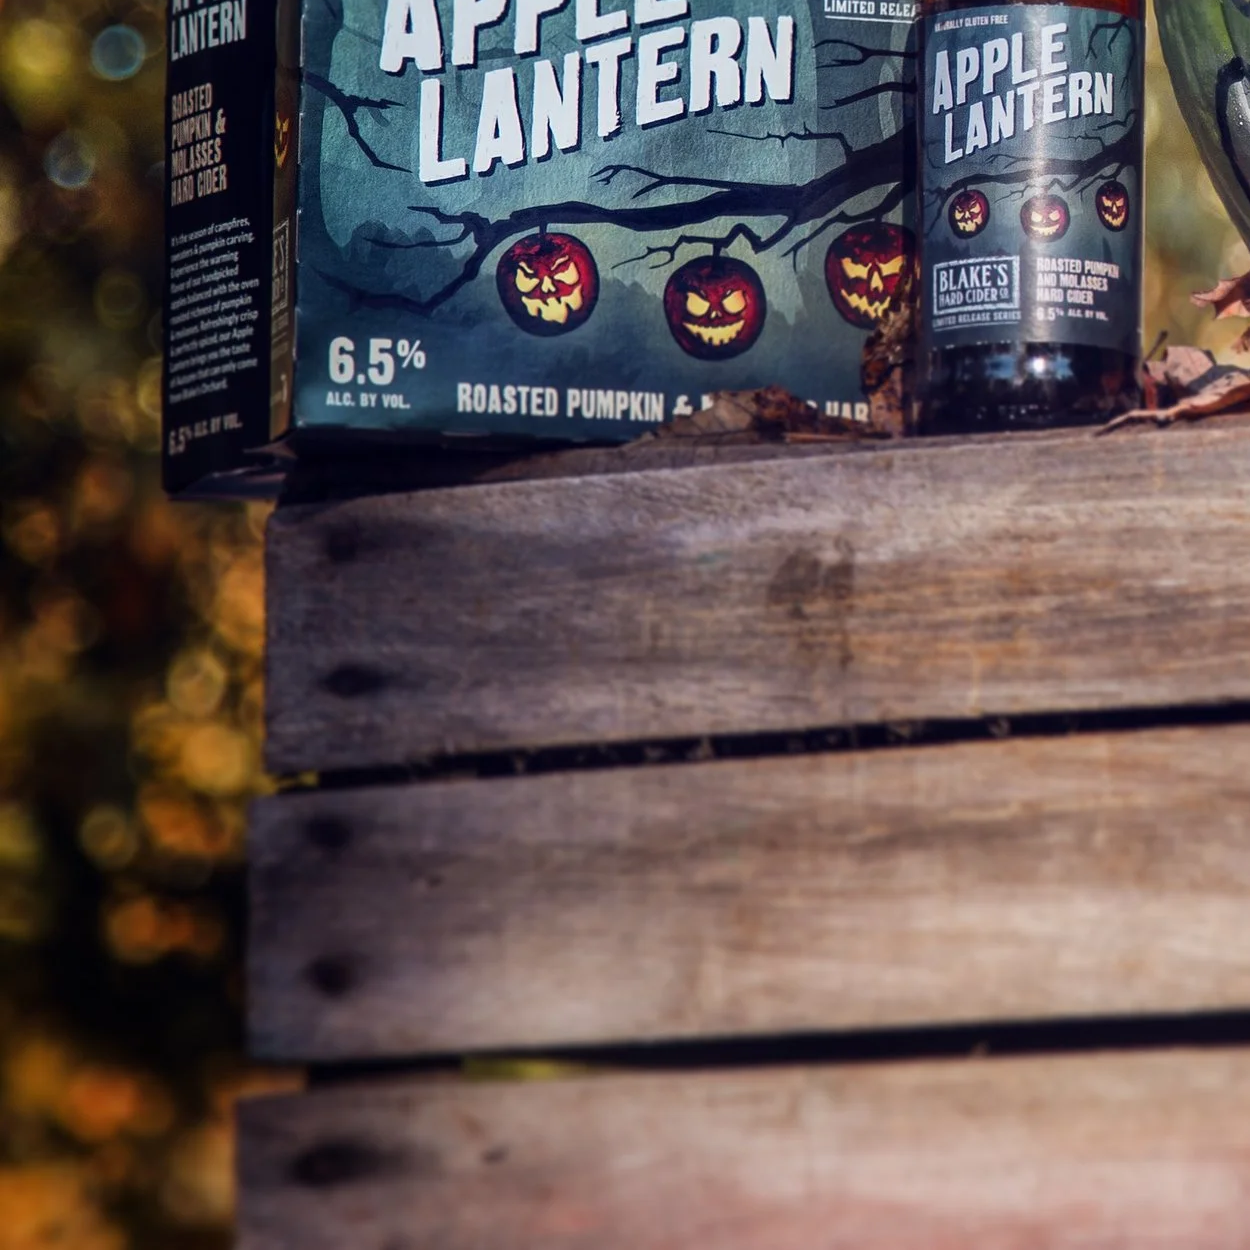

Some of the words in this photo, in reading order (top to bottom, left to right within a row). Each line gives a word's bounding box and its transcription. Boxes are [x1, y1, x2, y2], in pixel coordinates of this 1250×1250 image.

[965, 16, 989, 27] GLUTEN
[990, 14, 1008, 25] FREE
[933, 23, 1068, 114] APPLE
[172, 82, 212, 122] ROASTED
[419, 16, 795, 184] LANTERN
[945, 71, 1113, 164] LANTERN
[172, 111, 211, 150] PUMPKIN
[215, 107, 226, 135] &
[172, 137, 222, 180] MOLASSES
[171, 175, 194, 207] HARD
[197, 163, 227, 198] CIDER
[940, 263, 1009, 292] BLAKE'S
[1036, 257, 1082, 273] ROASTED
[1084, 260, 1119, 278] PUMPKIN
[228, 280, 240, 292] the
[241, 278, 259, 290] oven
[1037, 273, 1057, 287] AND
[1060, 274, 1108, 292] MOLASSES
[221, 293, 252, 312] pumpkin
[939, 291, 963, 307] HARD
[965, 288, 998, 304] CIDER
[1036, 287, 1064, 302] HARD
[1066, 289, 1094, 305] CIDER
[240, 309, 258, 322] crisp
[958, 312, 991, 323] RELEASE
[993, 311, 1021, 321] SERIES
[231, 325, 254, 340] Apple
[329, 336, 426, 385] 6.5%
[326, 391, 355, 407] ALC.
[360, 393, 377, 408] BY
[381, 394, 411, 410] VOL.
[457, 383, 558, 417] ROASTED
[566, 388, 665, 422] PUMPKIN
[673, 395, 693, 415] &
